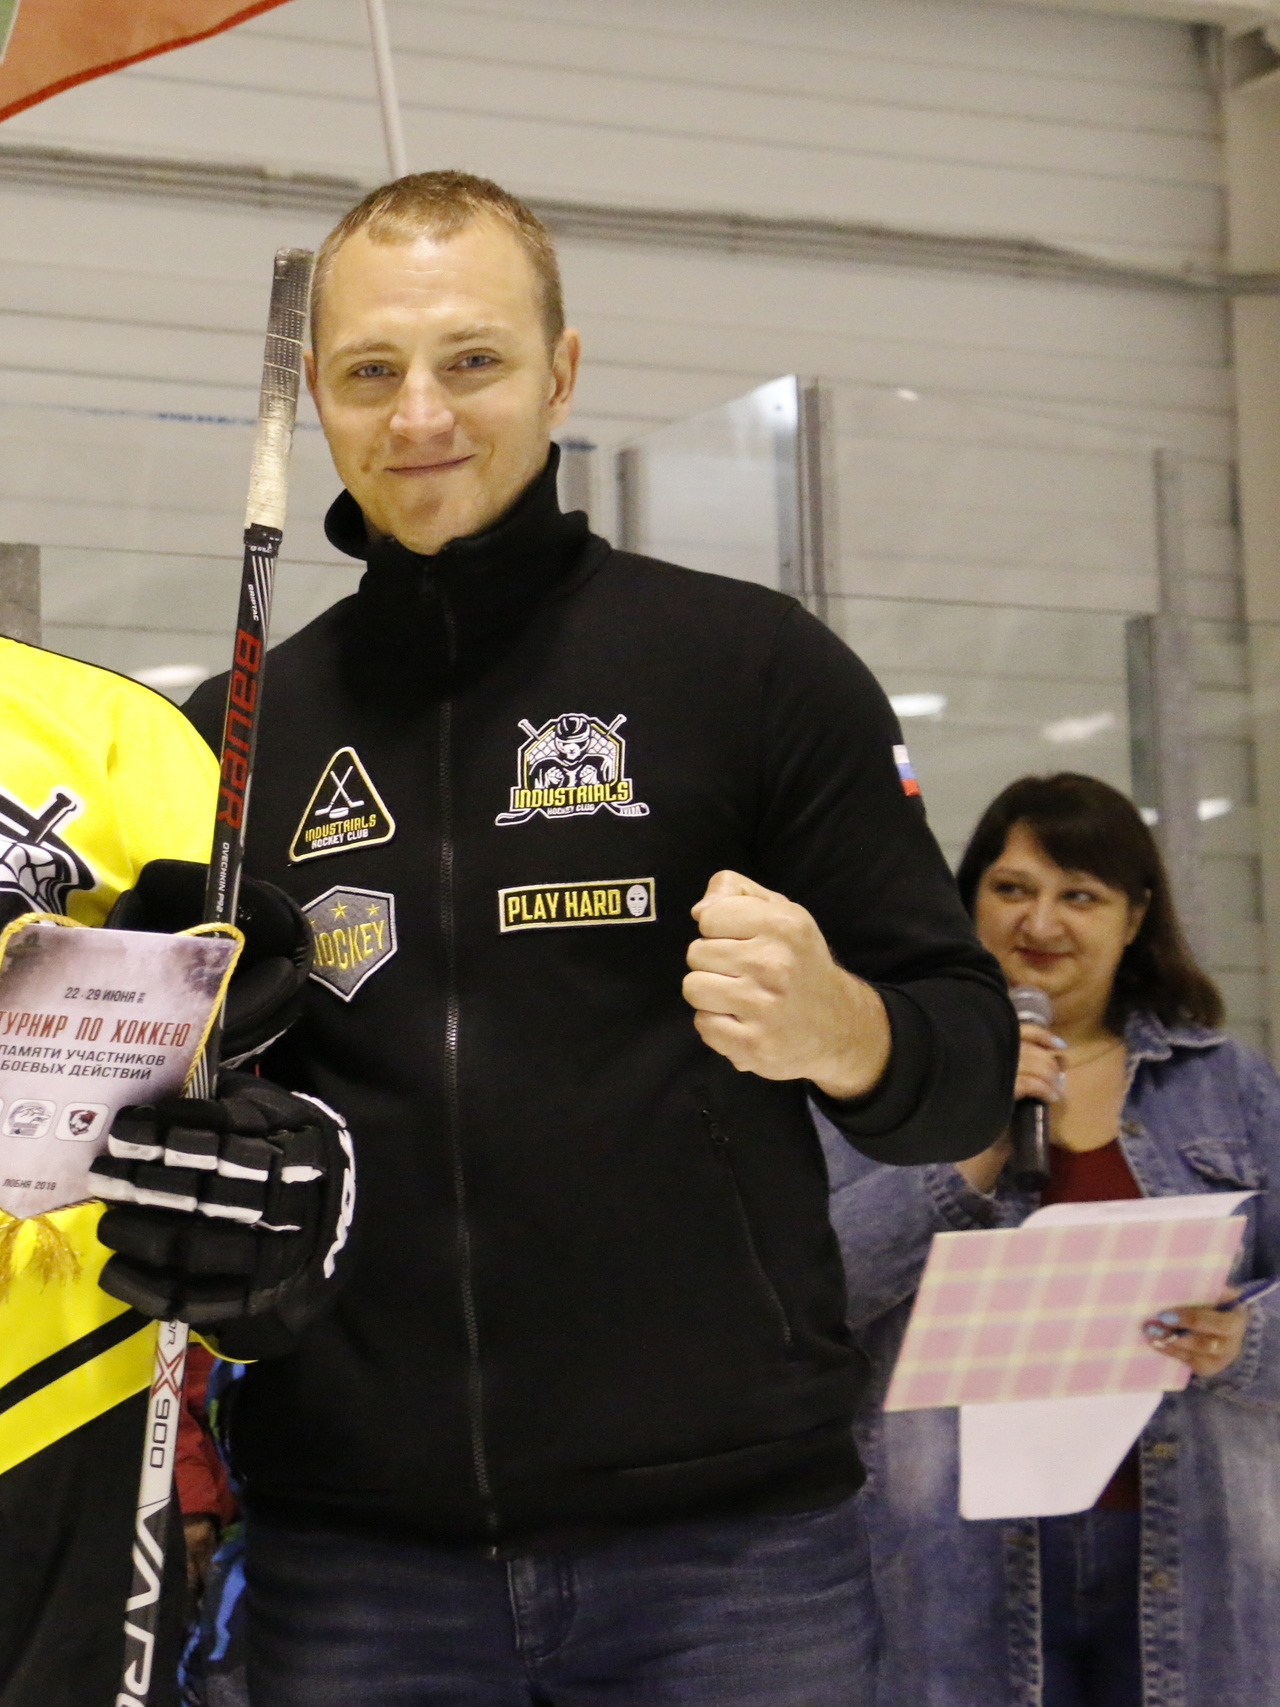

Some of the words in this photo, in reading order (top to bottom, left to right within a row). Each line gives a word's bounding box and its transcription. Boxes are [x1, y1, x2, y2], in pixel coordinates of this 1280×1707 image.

[248, 584, 259, 621] GRIPTAC
[514, 781, 629, 809] INDUSTRIALS
[547, 805, 575, 815] HOCKEY
[575, 803, 596, 812] CLUB
[305, 814, 377, 843] INDUSTRIALS
[311, 832, 344, 849] HOCKEY
[347, 829, 369, 842] CLUB
[218, 842, 230, 894] OVECHKIN
[507, 892, 559, 923] PLAY
[564, 889, 622, 918] HARD
[64, 987, 80, 999] 22
[86, 988, 102, 1001] 29
[102, 990, 137, 1003] ИЮНЯ
[75, 1017, 104, 1041] ПО
[110, 1019, 192, 1047] ХОККЕЮ
[0, 1059, 66, 1074] БОЕВЫХ
[68, 1063, 152, 1080] ДЕЙСТВИЙ
[65, 1049, 166, 1066] УЧАСТНИКОВ
